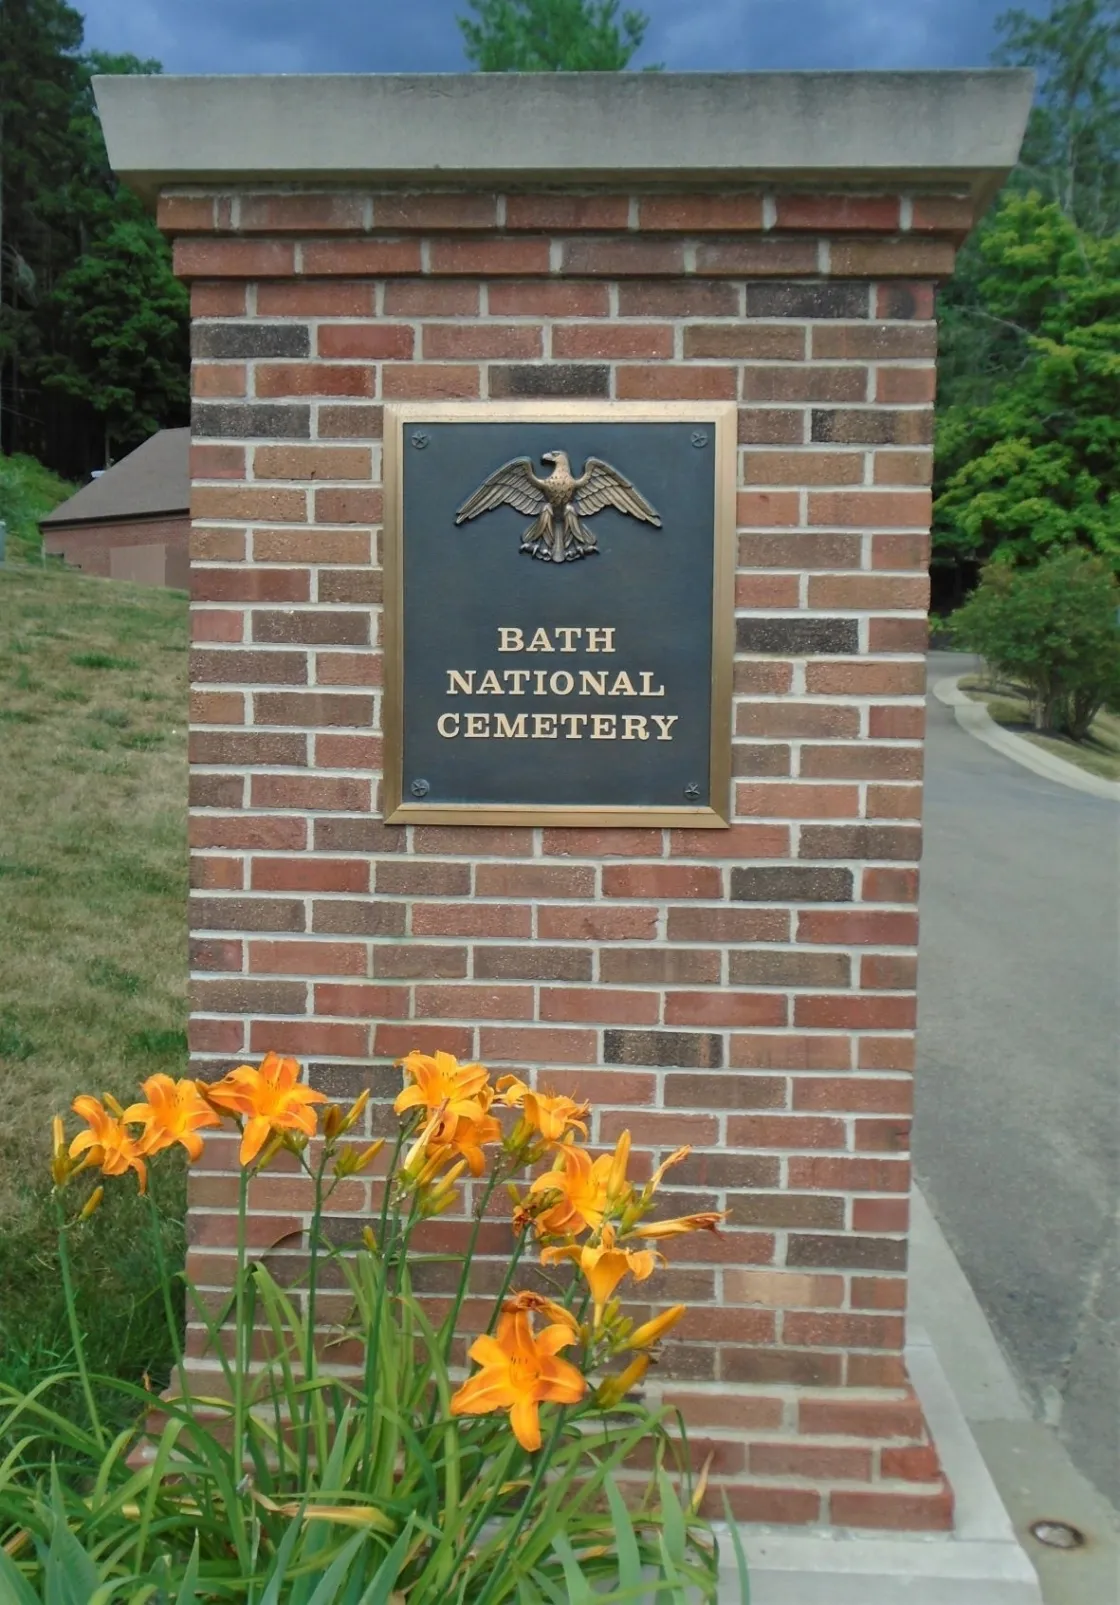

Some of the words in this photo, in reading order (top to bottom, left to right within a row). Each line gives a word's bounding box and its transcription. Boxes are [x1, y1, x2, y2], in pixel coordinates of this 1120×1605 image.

[497, 627, 616, 653] BATH
[446, 669, 666, 697] NATIONAL
[436, 712, 679, 742] CEMETERY
